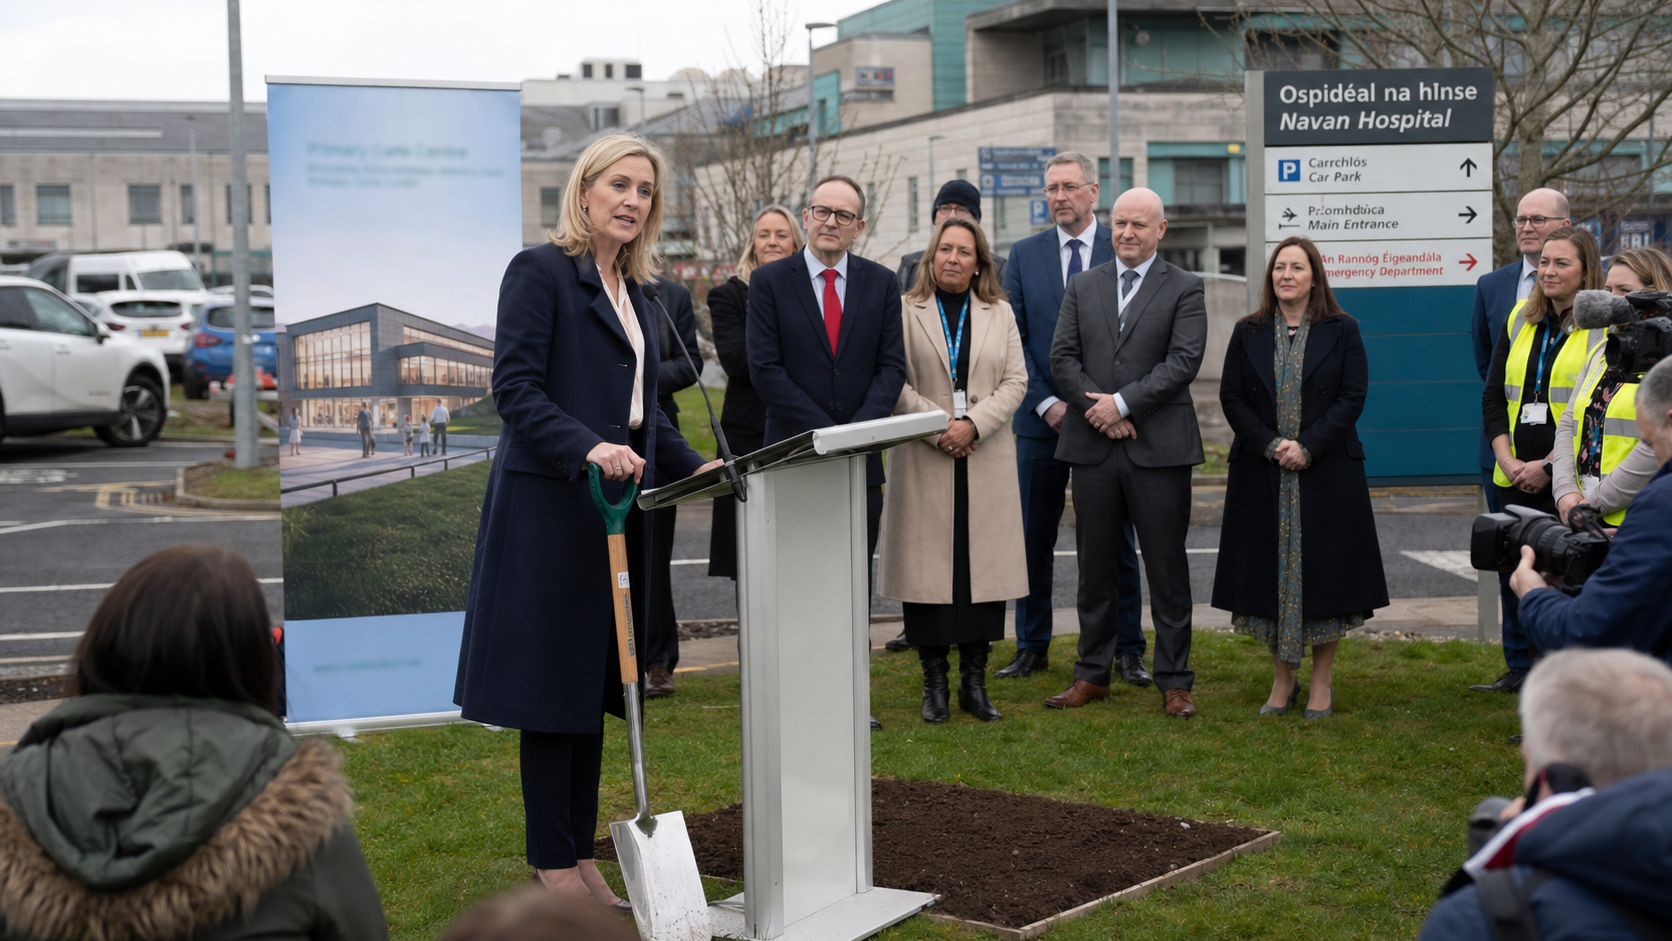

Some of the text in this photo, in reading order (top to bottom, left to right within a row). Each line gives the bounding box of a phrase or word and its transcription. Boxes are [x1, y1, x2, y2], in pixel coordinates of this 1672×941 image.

[1279, 82, 1376, 108] Ospidéal
[1384, 87, 1411, 102] na
[1279, 108, 1452, 133] Navan Hospital
[1308, 157, 1367, 168] Carrchlós
[1308, 171, 1362, 182] Car Park
[1308, 219, 1399, 230] Main Entrance
[1321, 250, 1442, 266] An Rannóg Éigeandála
[1325, 266, 1444, 279] mergency Department
